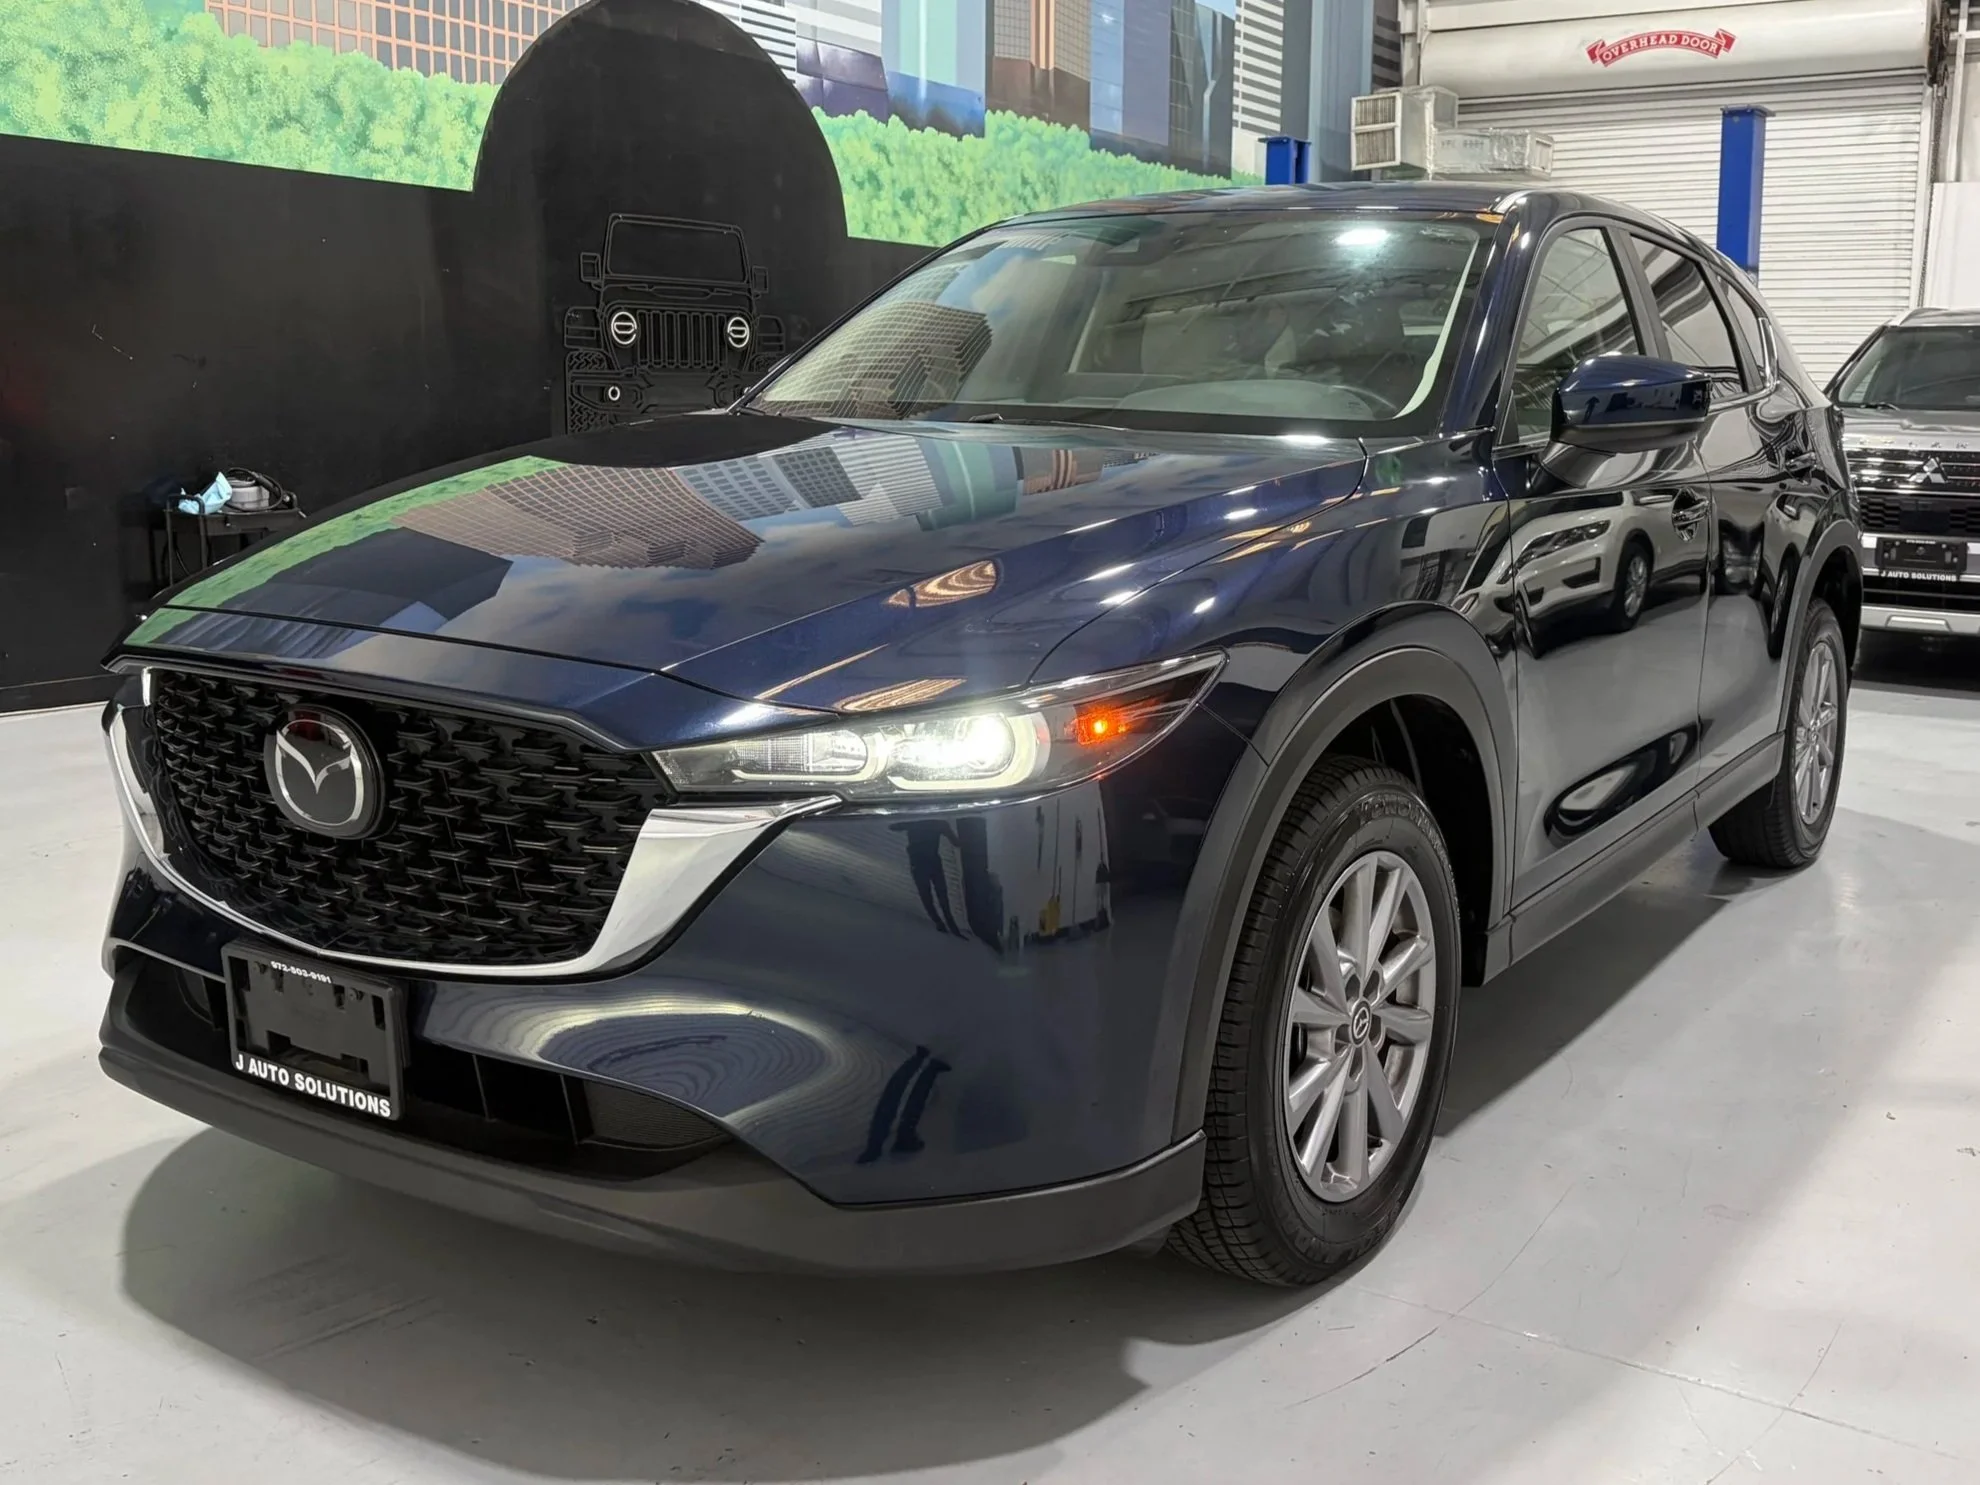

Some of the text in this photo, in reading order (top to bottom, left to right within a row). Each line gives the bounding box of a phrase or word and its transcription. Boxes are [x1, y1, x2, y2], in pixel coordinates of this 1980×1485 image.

[1602, 35, 1717, 61] OVERHEAD DOOR
[1911, 573, 1957, 582] SOLUTIONS
[235, 1054, 391, 1117] J AUTO SOLUTIONS
